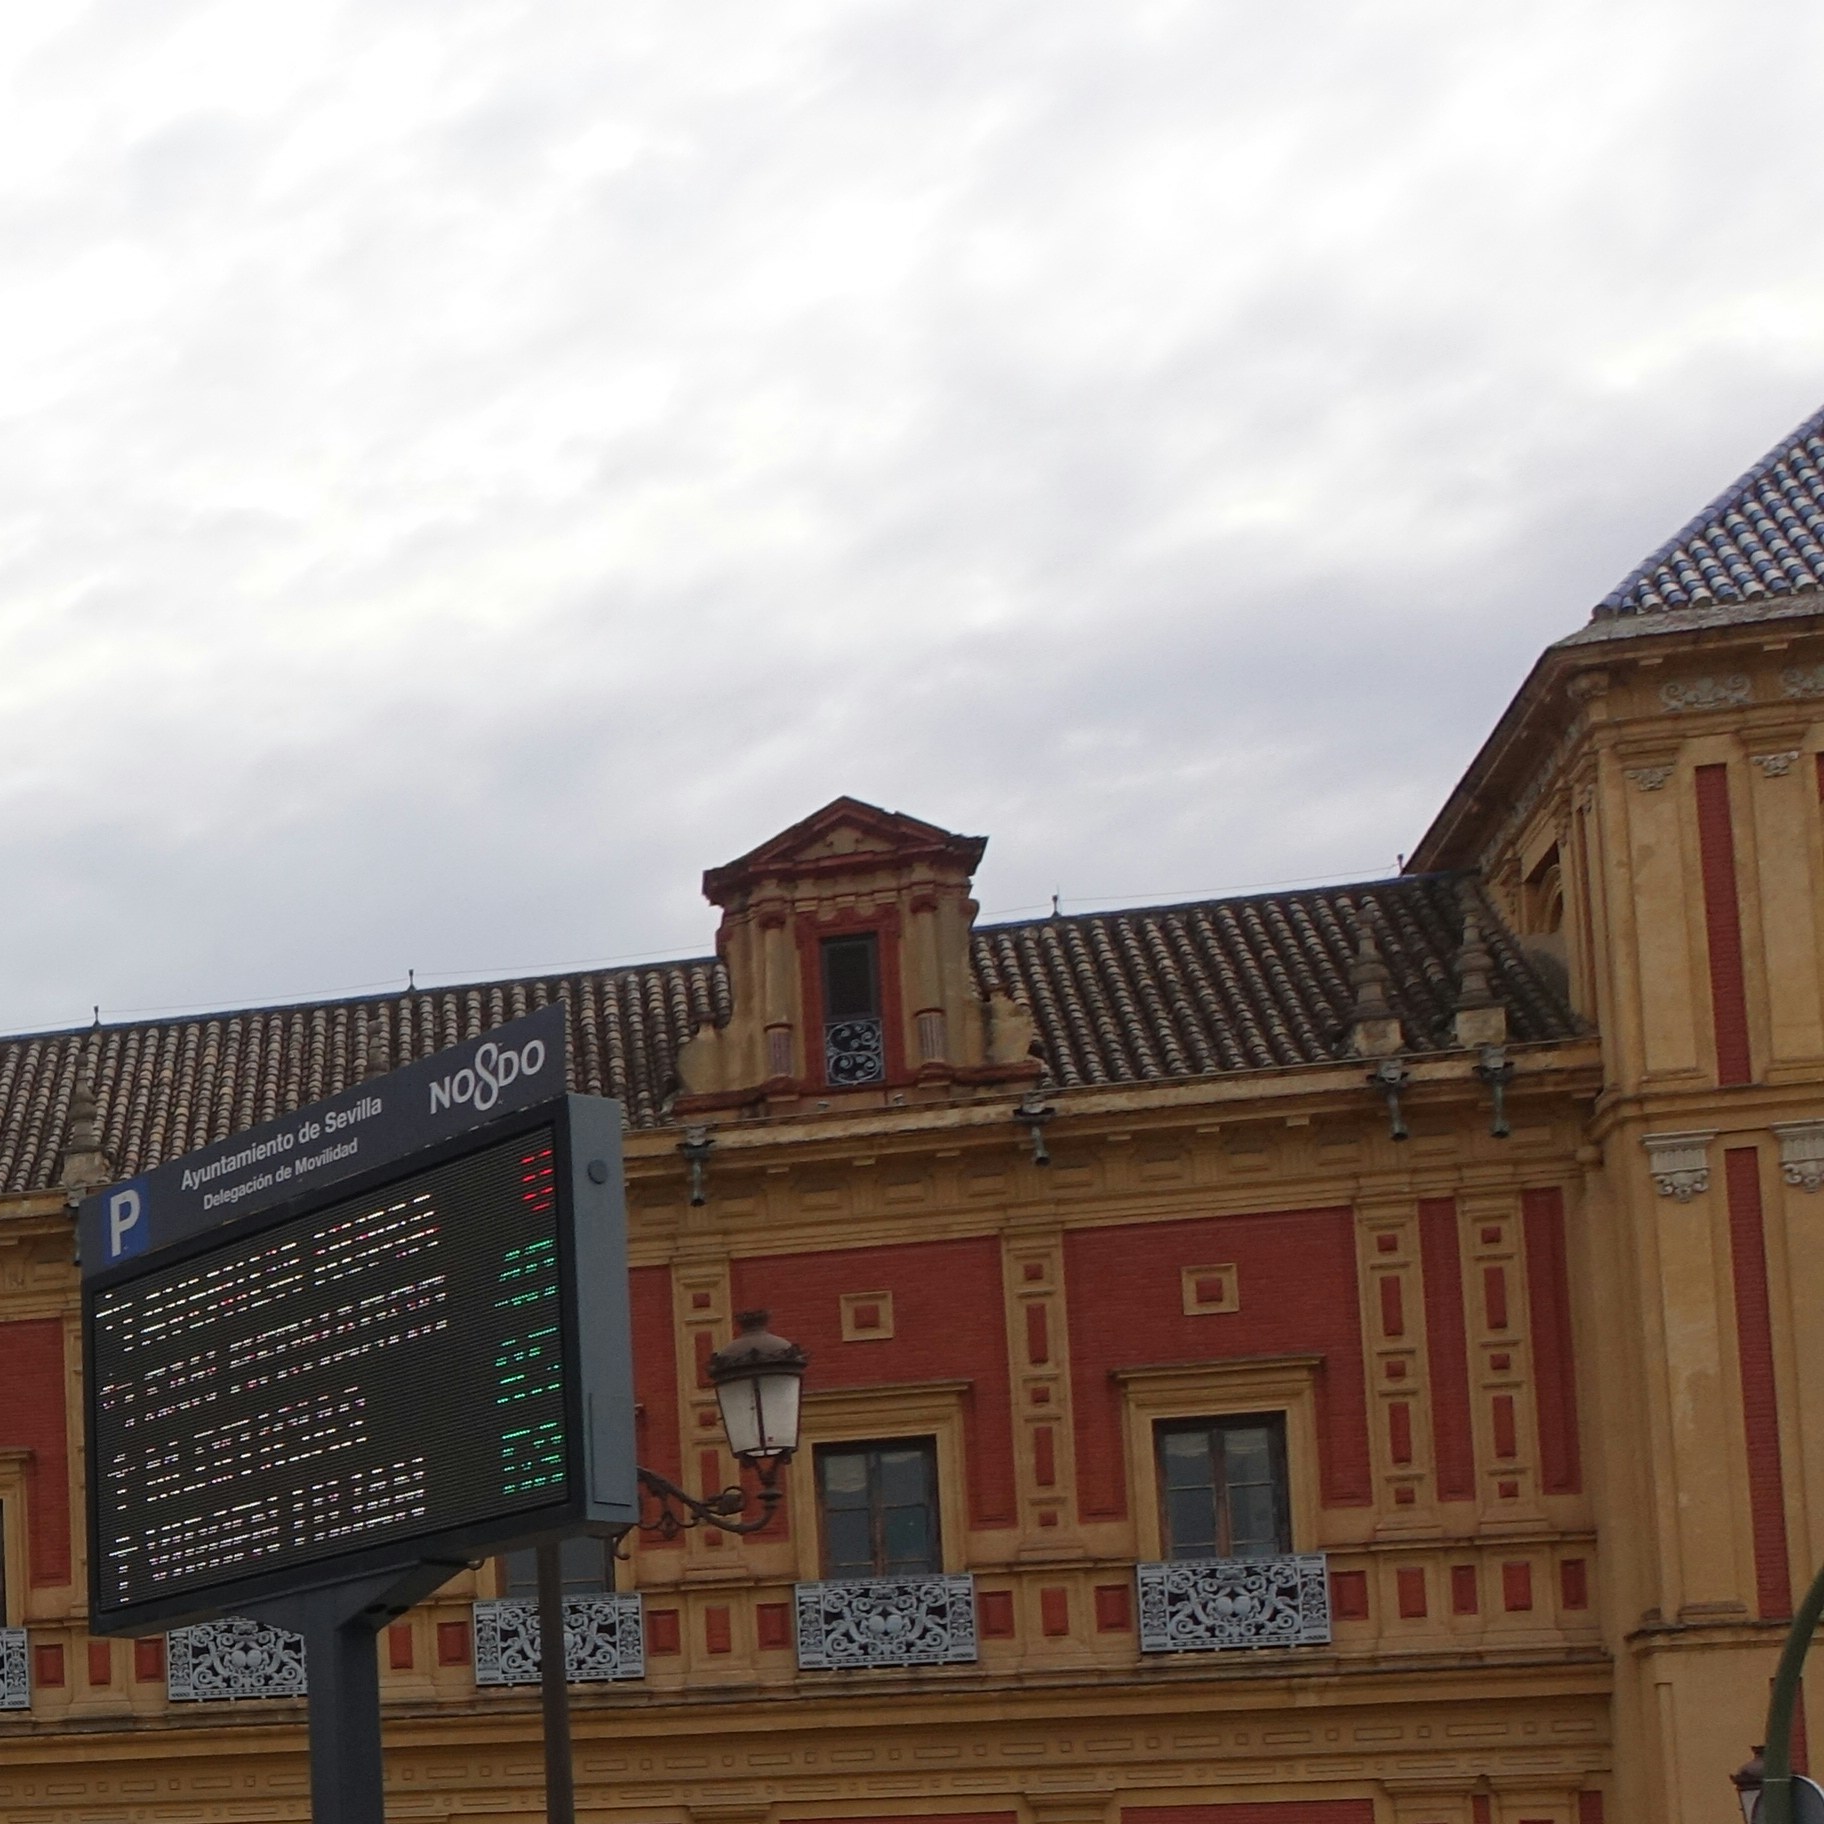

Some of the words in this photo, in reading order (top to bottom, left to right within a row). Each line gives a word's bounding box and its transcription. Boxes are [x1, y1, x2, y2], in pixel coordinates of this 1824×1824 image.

[181, 1131, 294, 1191] Ayuntamiento
[299, 1122, 321, 1144] de
[325, 1096, 382, 1134] Sevilla
[203, 1172, 272, 1210] Delegación
[276, 1163, 292, 1182] de
[295, 1138, 358, 1175] Movilidad
[110, 1188, 141, 1258] P
